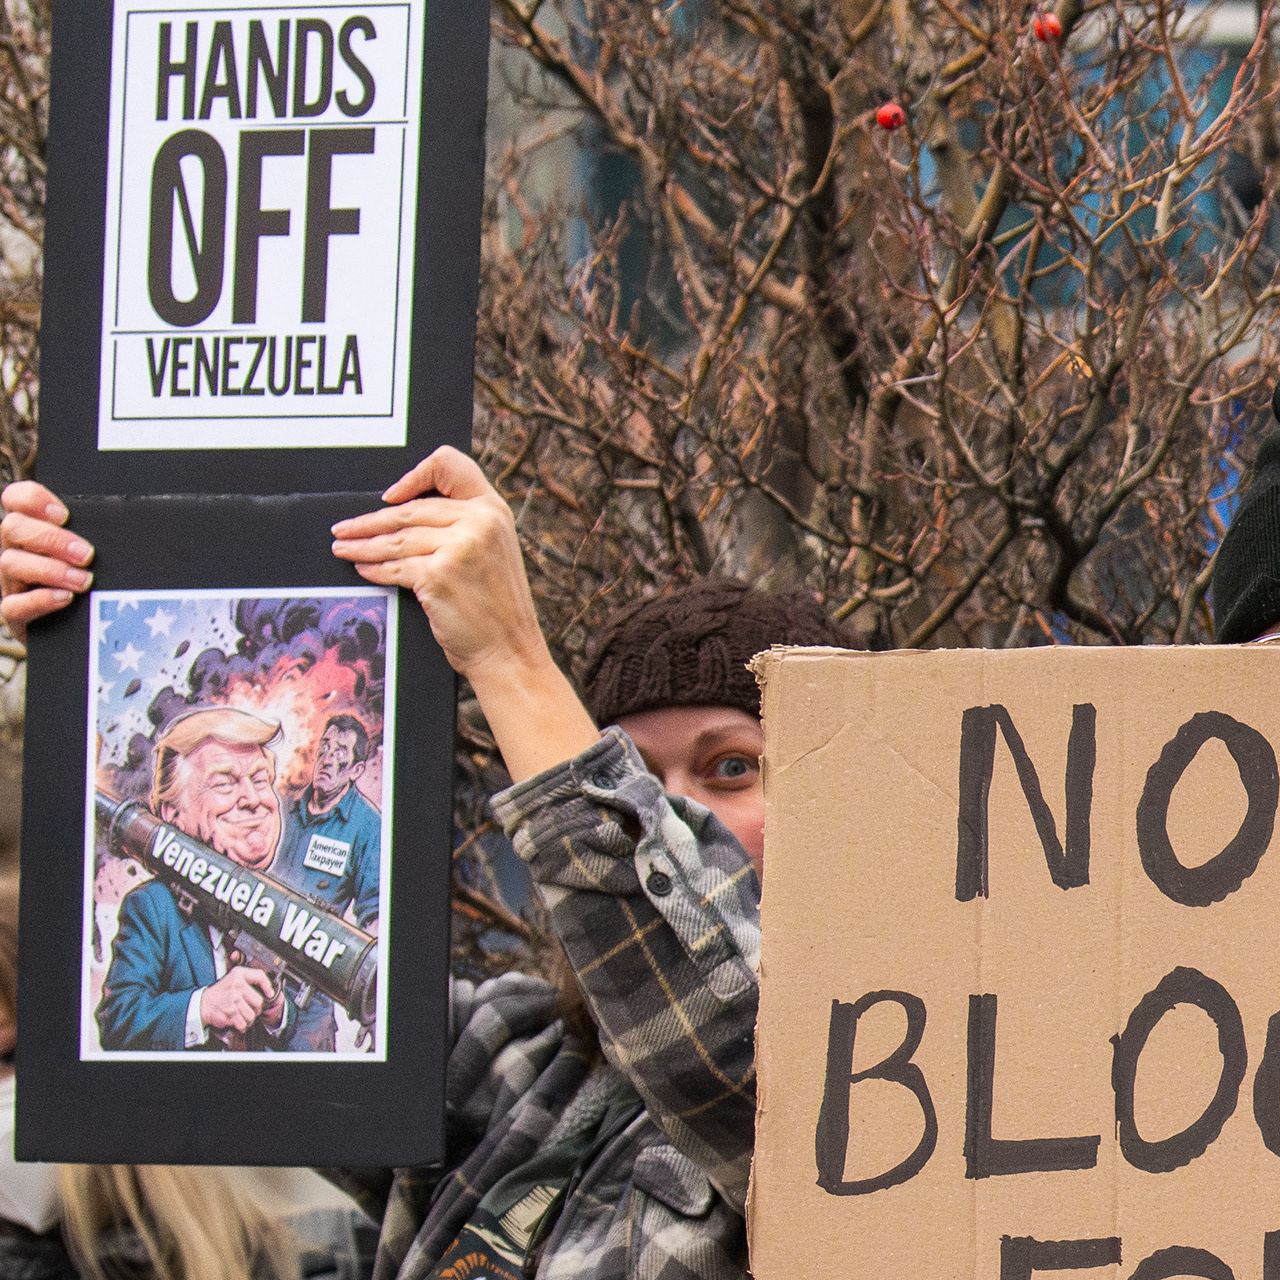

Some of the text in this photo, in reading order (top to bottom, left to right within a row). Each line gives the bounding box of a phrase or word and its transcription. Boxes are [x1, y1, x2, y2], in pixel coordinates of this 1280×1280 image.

[156, 15, 377, 121] HANDS
[147, 127, 376, 328] OFF
[145, 334, 363, 397] VENEZUELA
[310, 840, 347, 857] American
[955, 703, 1280, 907] NO
[151, 826, 346, 968] Venezuela War
[309, 849, 344, 870] Taxpayer
